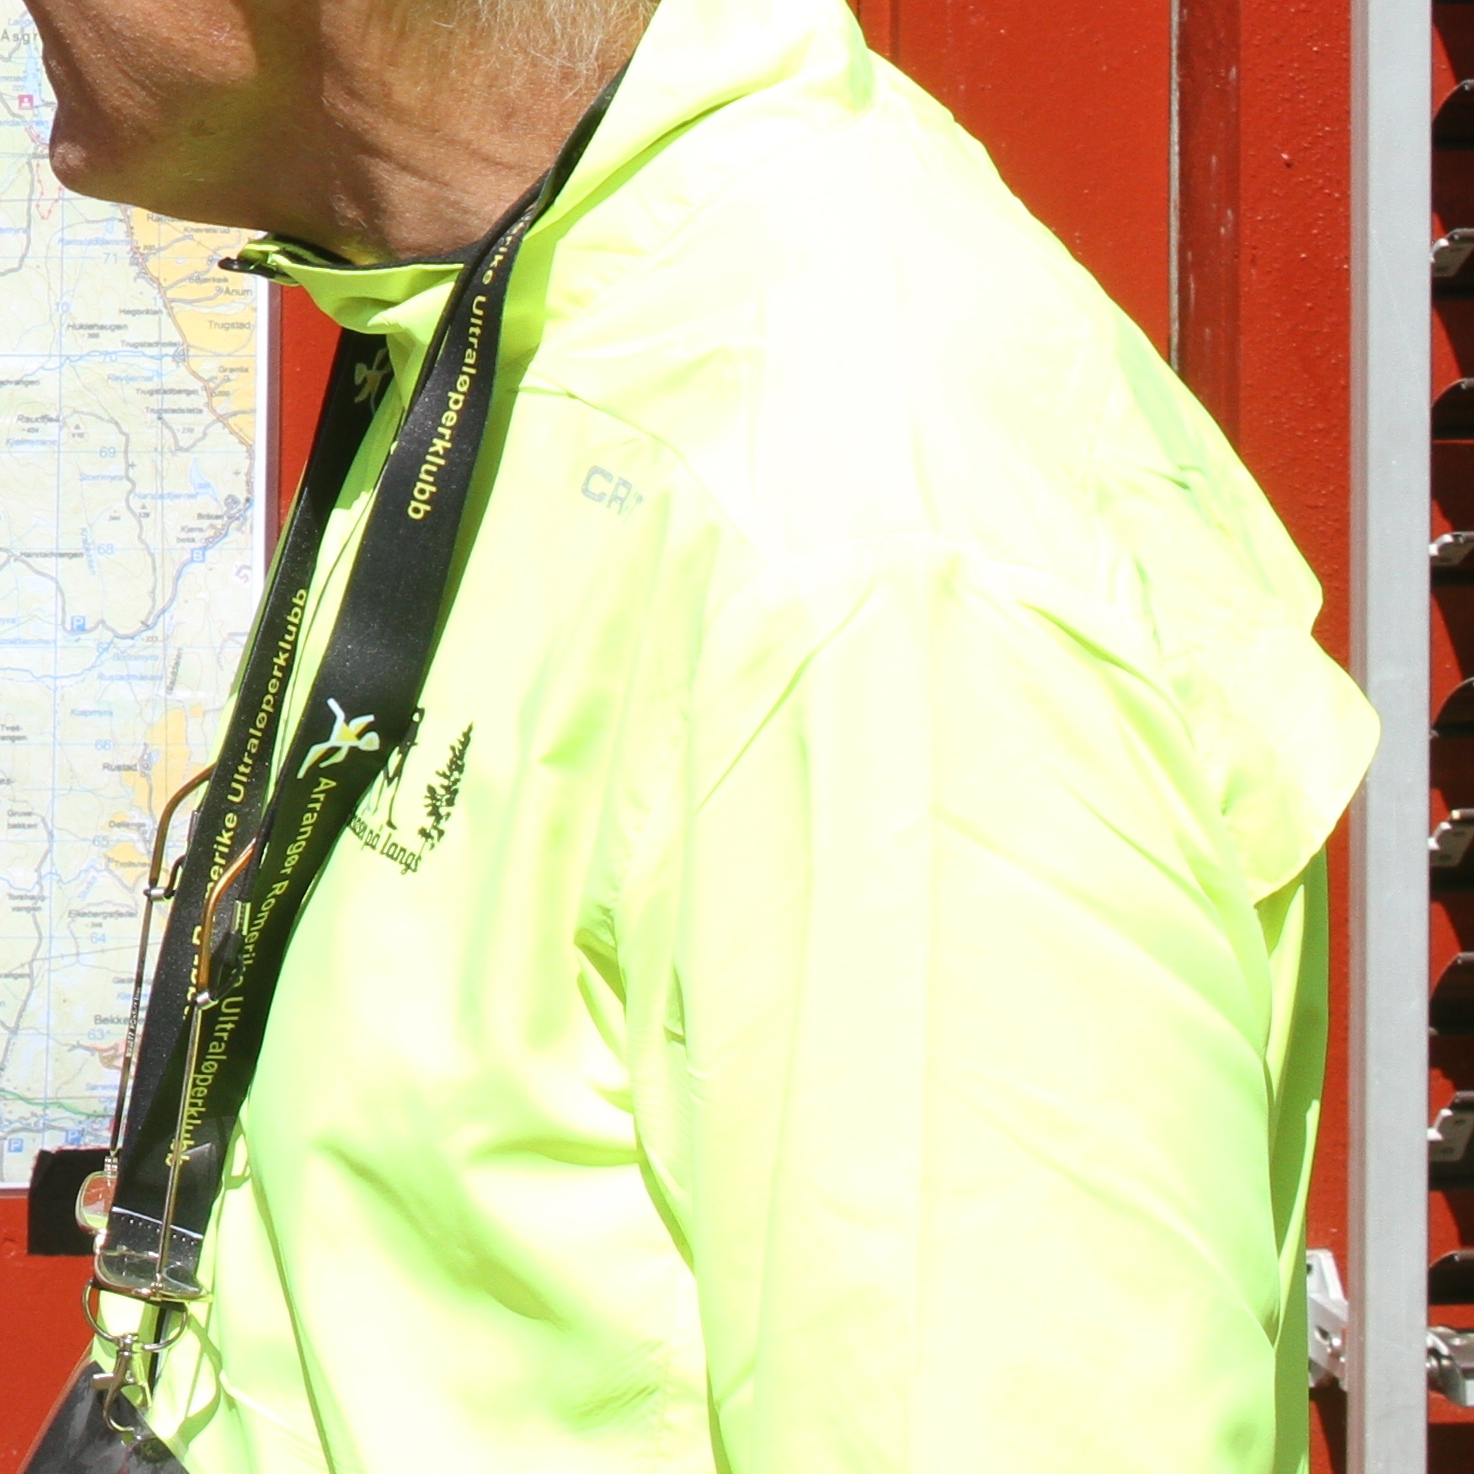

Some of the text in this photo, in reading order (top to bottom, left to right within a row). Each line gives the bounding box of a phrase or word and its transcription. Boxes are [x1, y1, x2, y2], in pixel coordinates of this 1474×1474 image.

[408, 295, 487, 520] Ultraløperklubb
[100, 447, 115, 458] 69
[97, 545, 114, 555] 68
[228, 589, 308, 803] Ultraløperklubb
[94, 739, 111, 750] 66
[278, 776, 337, 876] Arrangør
